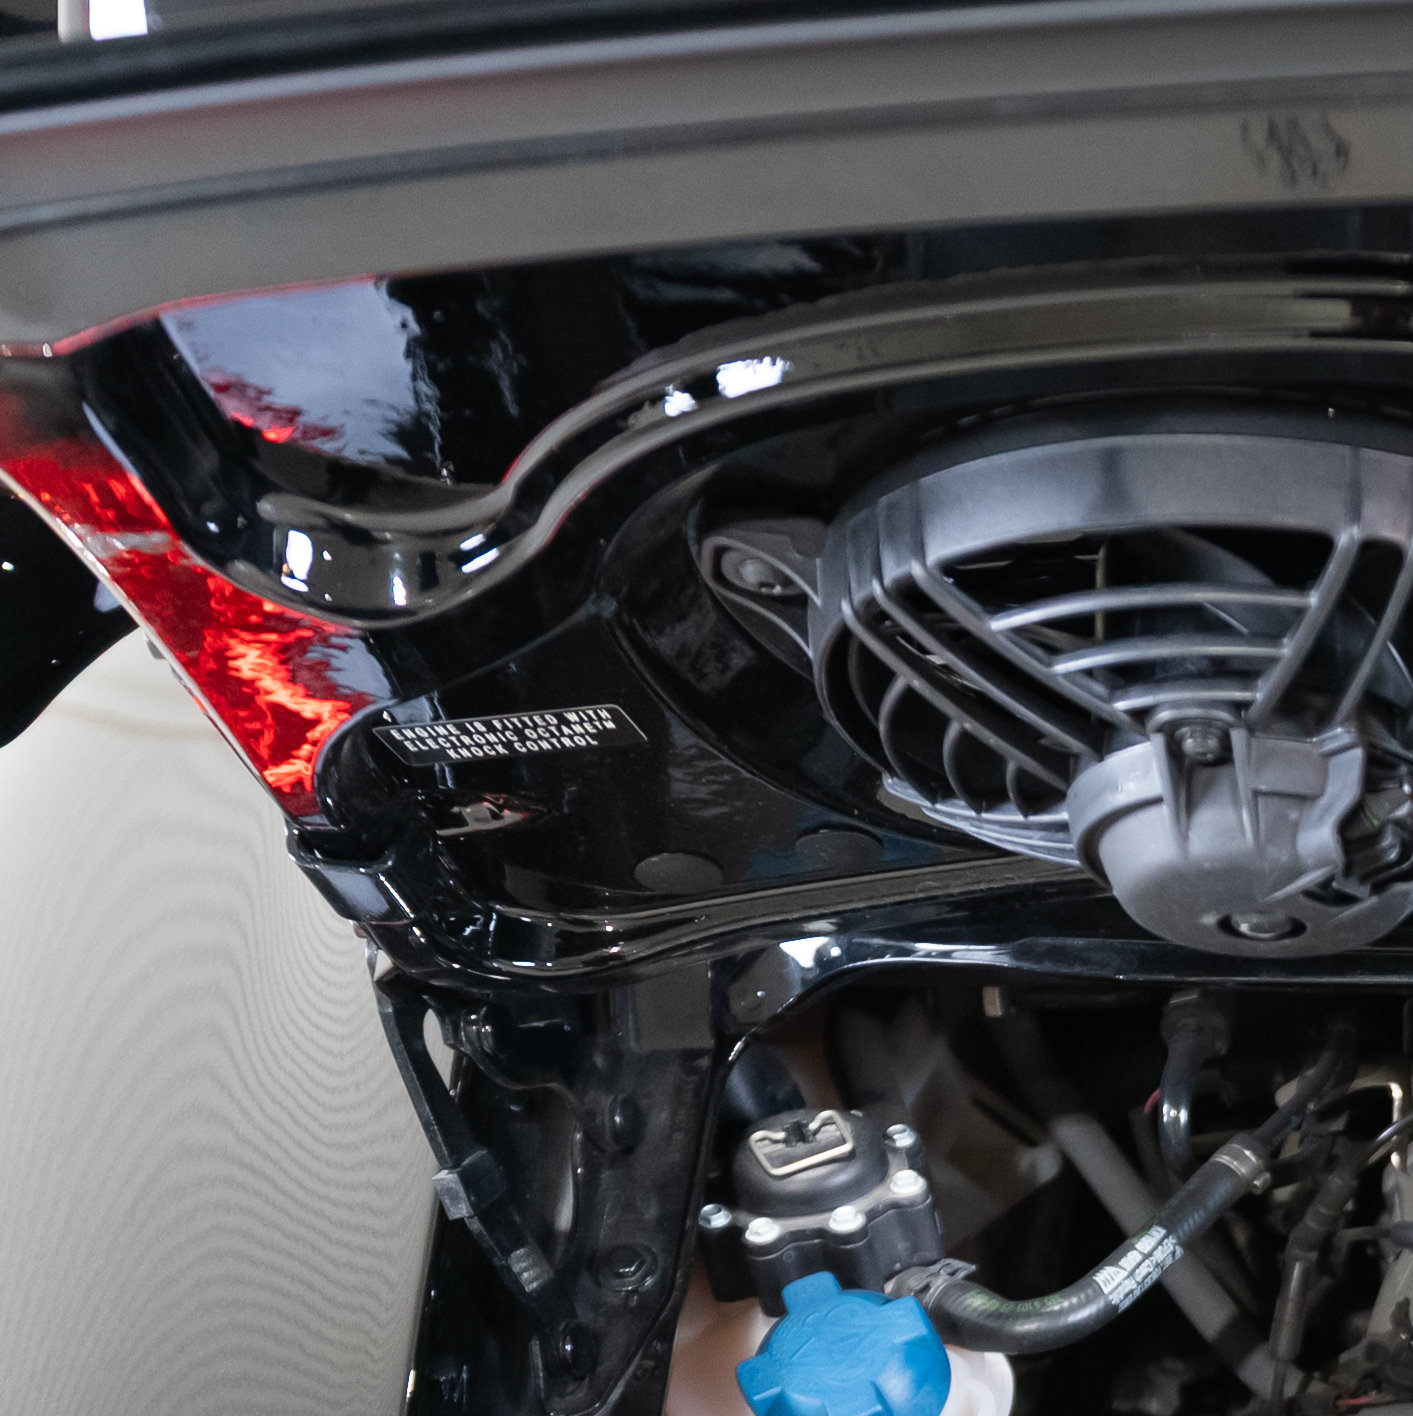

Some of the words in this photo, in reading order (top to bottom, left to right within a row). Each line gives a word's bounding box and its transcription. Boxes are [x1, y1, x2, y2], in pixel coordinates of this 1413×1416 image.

[389, 724, 461, 741] ENGINE
[465, 720, 487, 734] IS
[492, 713, 558, 731] FITTED
[563, 708, 612, 723] WITH
[403, 731, 518, 752] ELECTRONIC
[446, 743, 509, 760] KNOCK
[514, 734, 598, 753] CONTROL
